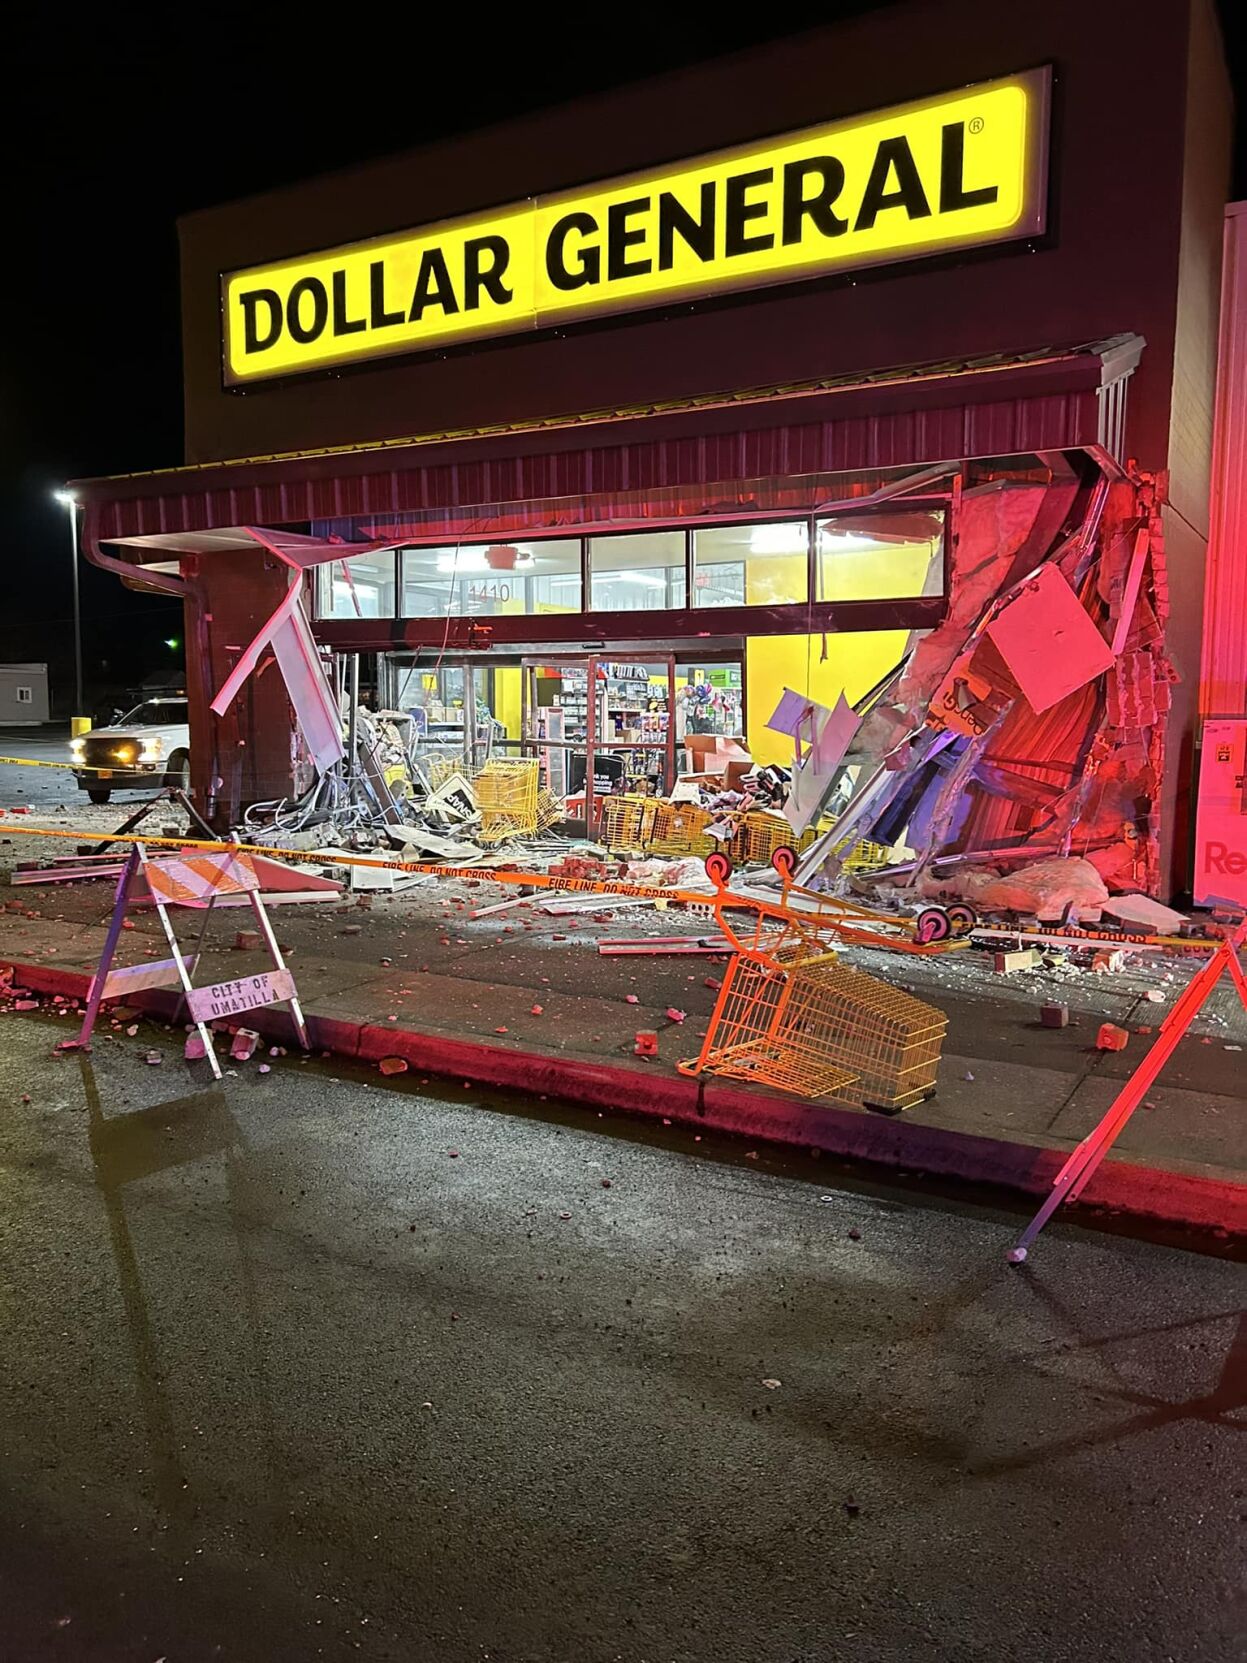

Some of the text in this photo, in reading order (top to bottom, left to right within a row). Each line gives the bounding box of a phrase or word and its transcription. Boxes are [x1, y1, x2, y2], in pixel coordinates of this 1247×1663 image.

[239, 234, 513, 354] DOLLAR
[545, 121, 998, 292] GENERAL
[469, 584, 510, 605] 1410
[446, 795, 473, 819] SNAP
[382, 862, 496, 881] FIRE LINE DO NOT CROSS
[549, 878, 571, 890] FIRE
[574, 881, 597, 892] LINE
[211, 976, 268, 998] CITY OF
[211, 989, 280, 1015] UMATILLA
